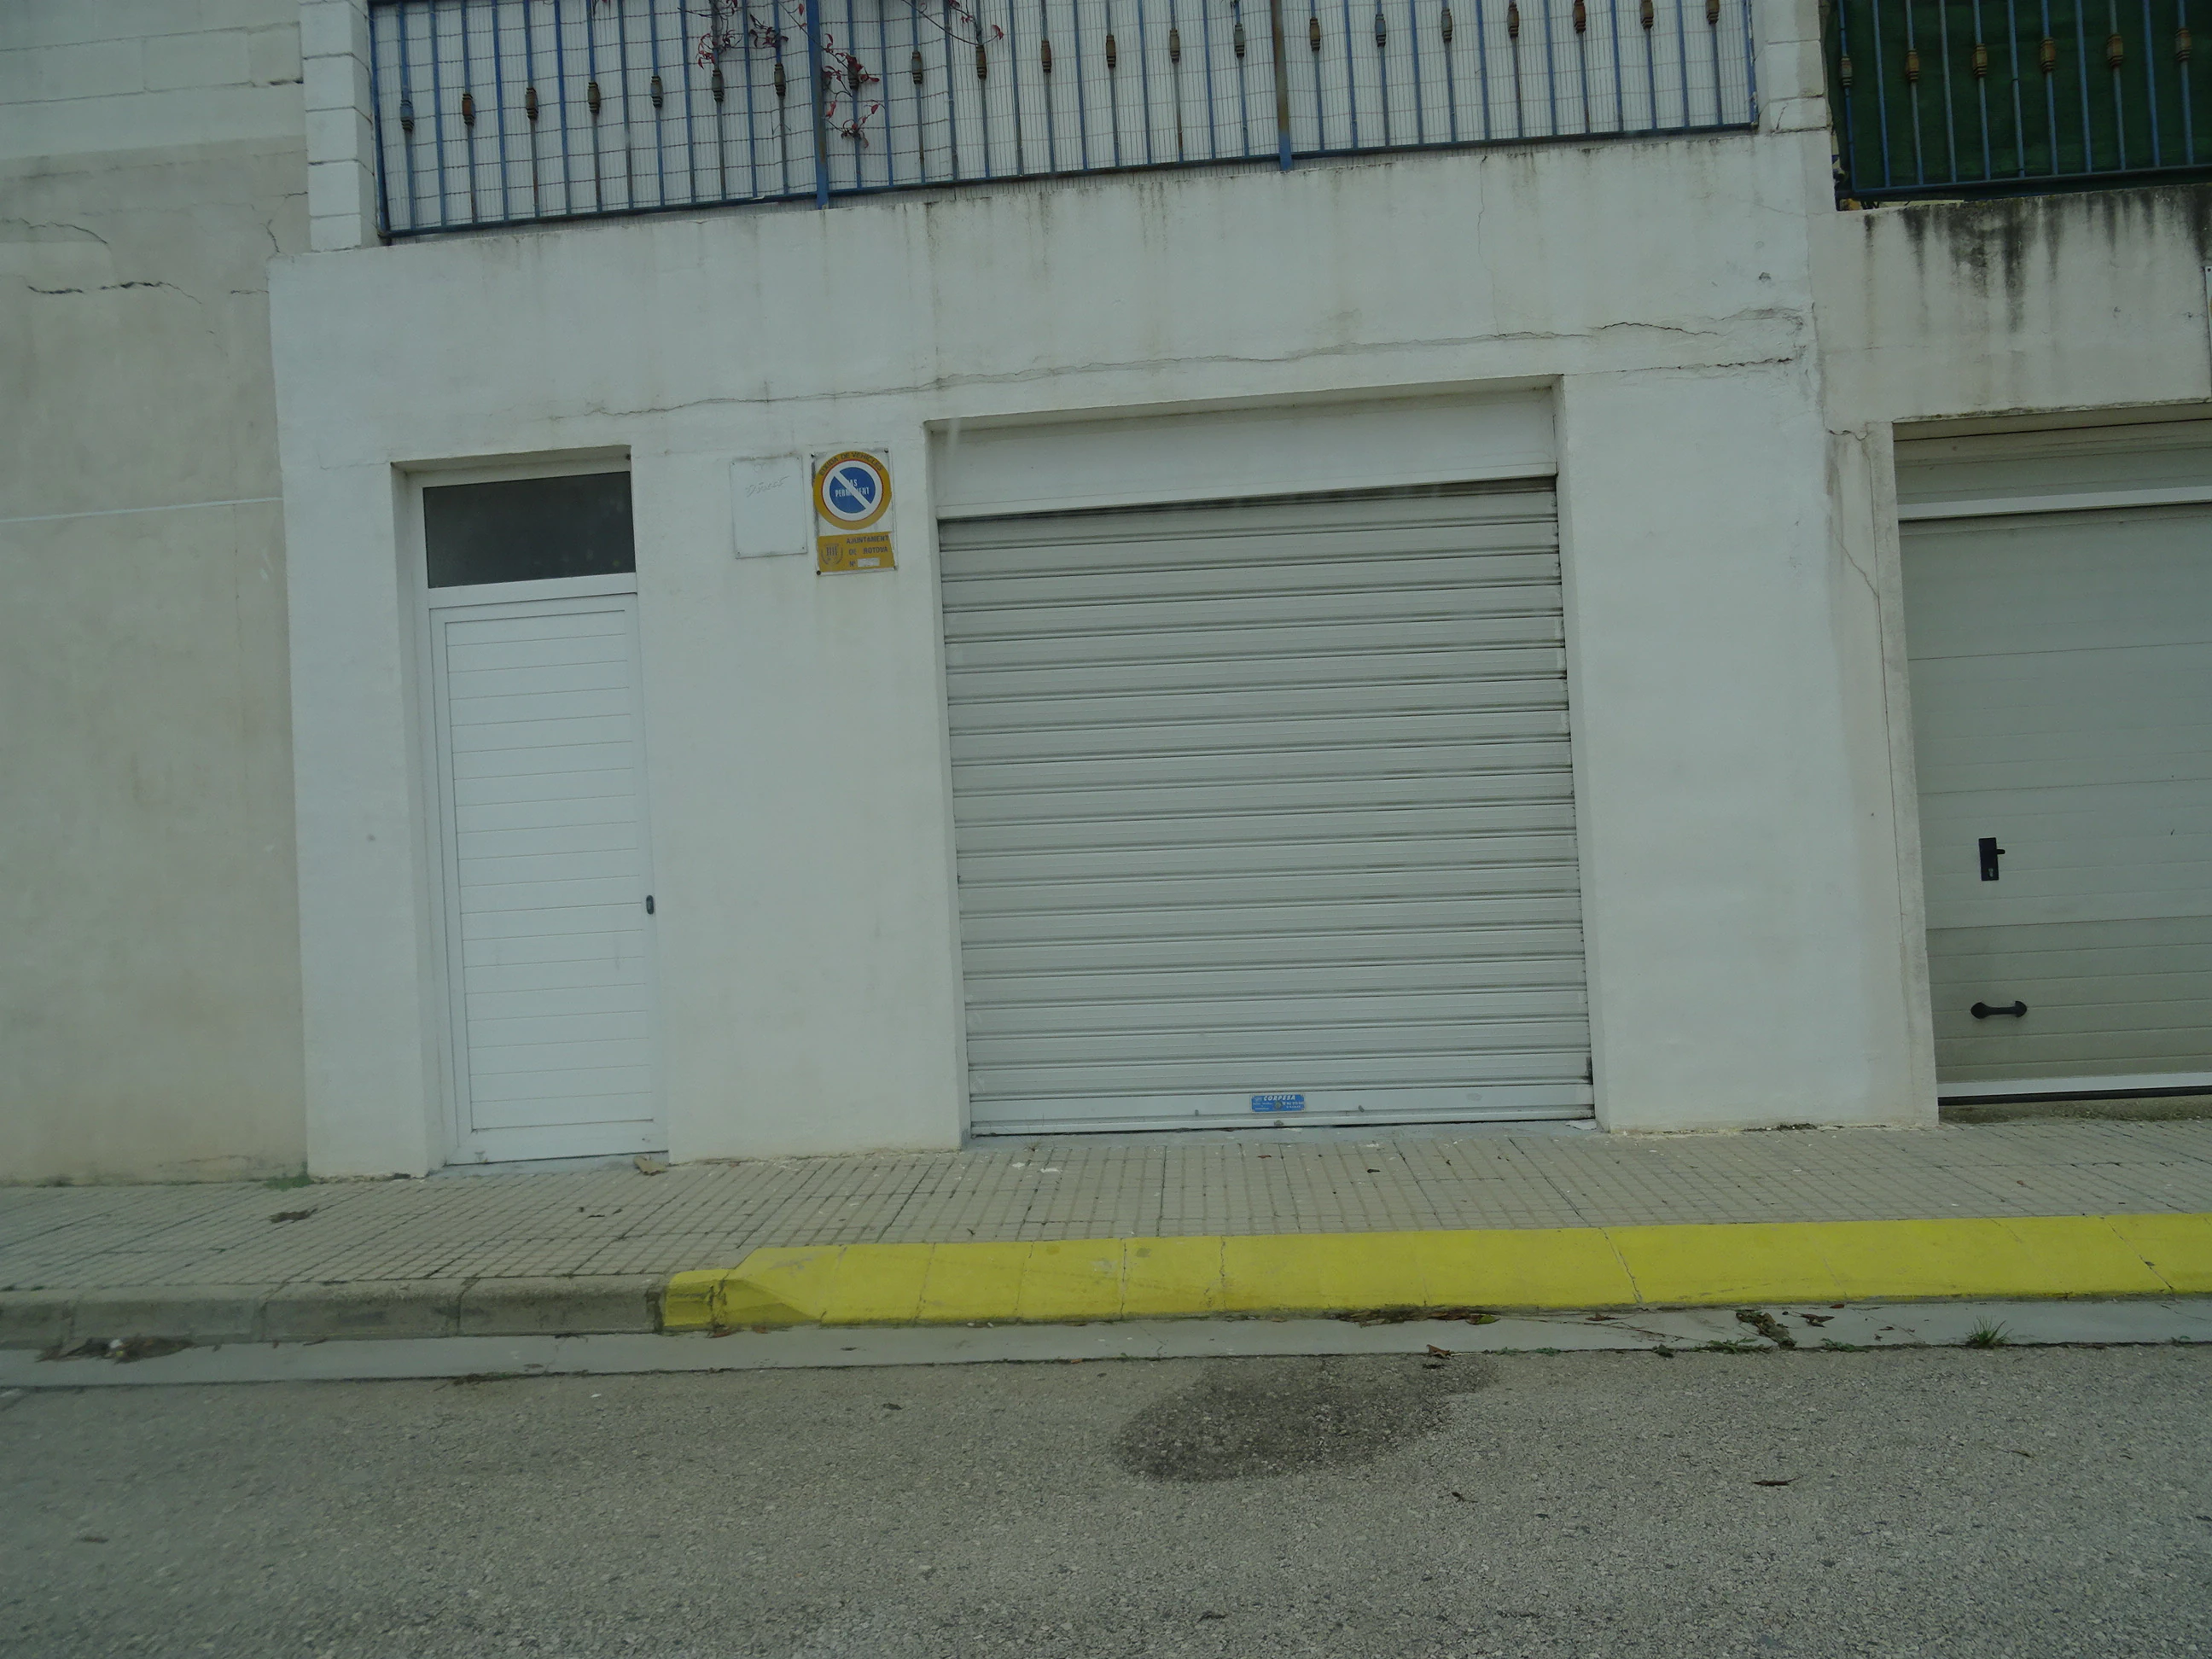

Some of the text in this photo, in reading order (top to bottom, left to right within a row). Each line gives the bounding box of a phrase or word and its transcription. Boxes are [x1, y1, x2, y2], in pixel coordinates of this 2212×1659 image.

[818, 456, 839, 475] EIXIDA
[852, 451, 882, 471] VEHICLES
[846, 534, 889, 544] AJUNTAMENT
